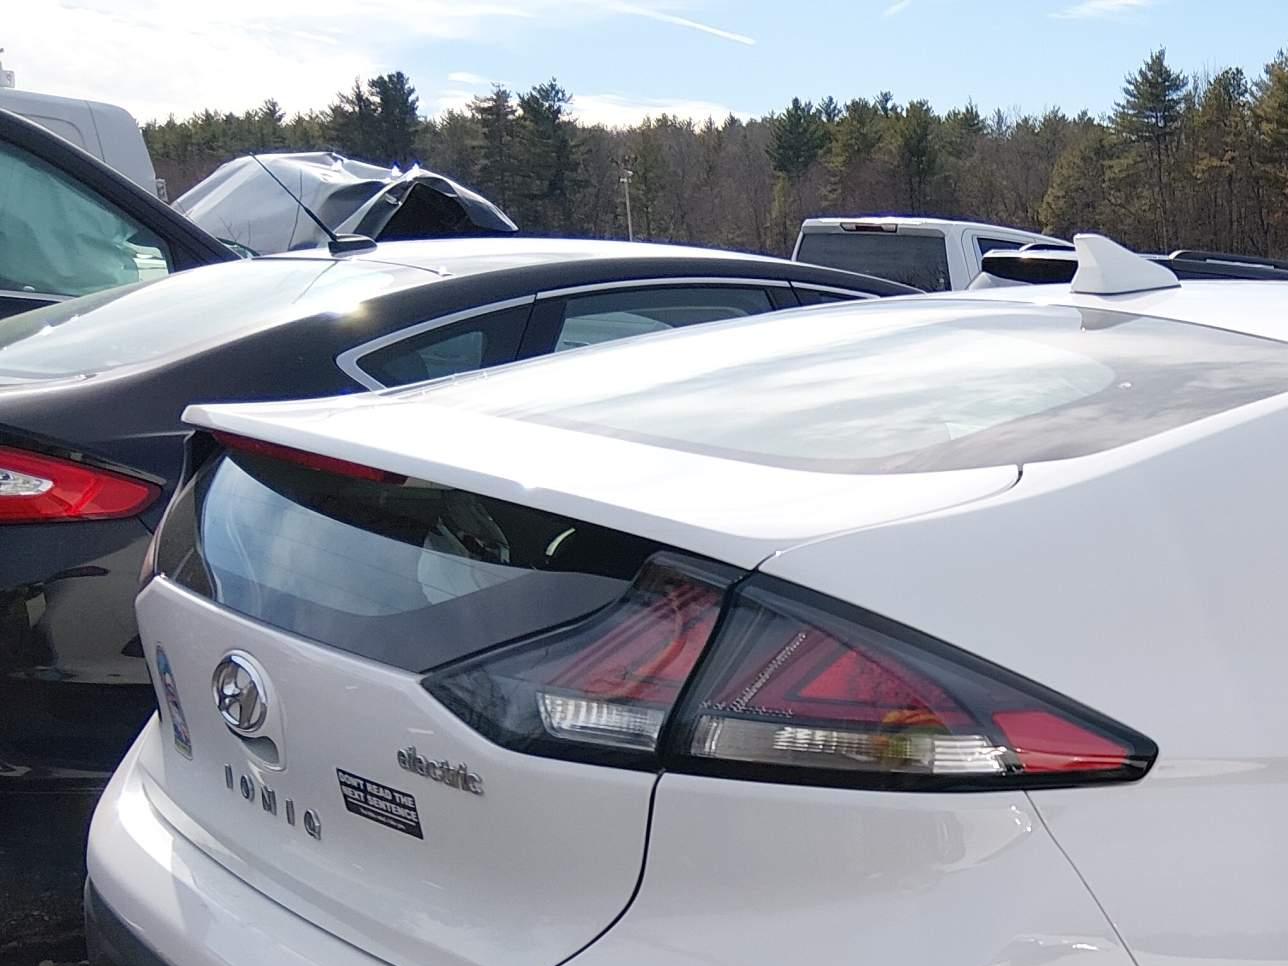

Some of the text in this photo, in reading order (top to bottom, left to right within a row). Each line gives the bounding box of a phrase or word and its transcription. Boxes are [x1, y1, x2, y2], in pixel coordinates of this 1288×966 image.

[397, 745, 484, 795] electric
[223, 762, 323, 842] IONIQ
[341, 785, 365, 802] NEXT
[366, 795, 418, 822] SENTENCE
[365, 782, 392, 800] READ
[392, 792, 414, 808] THE
